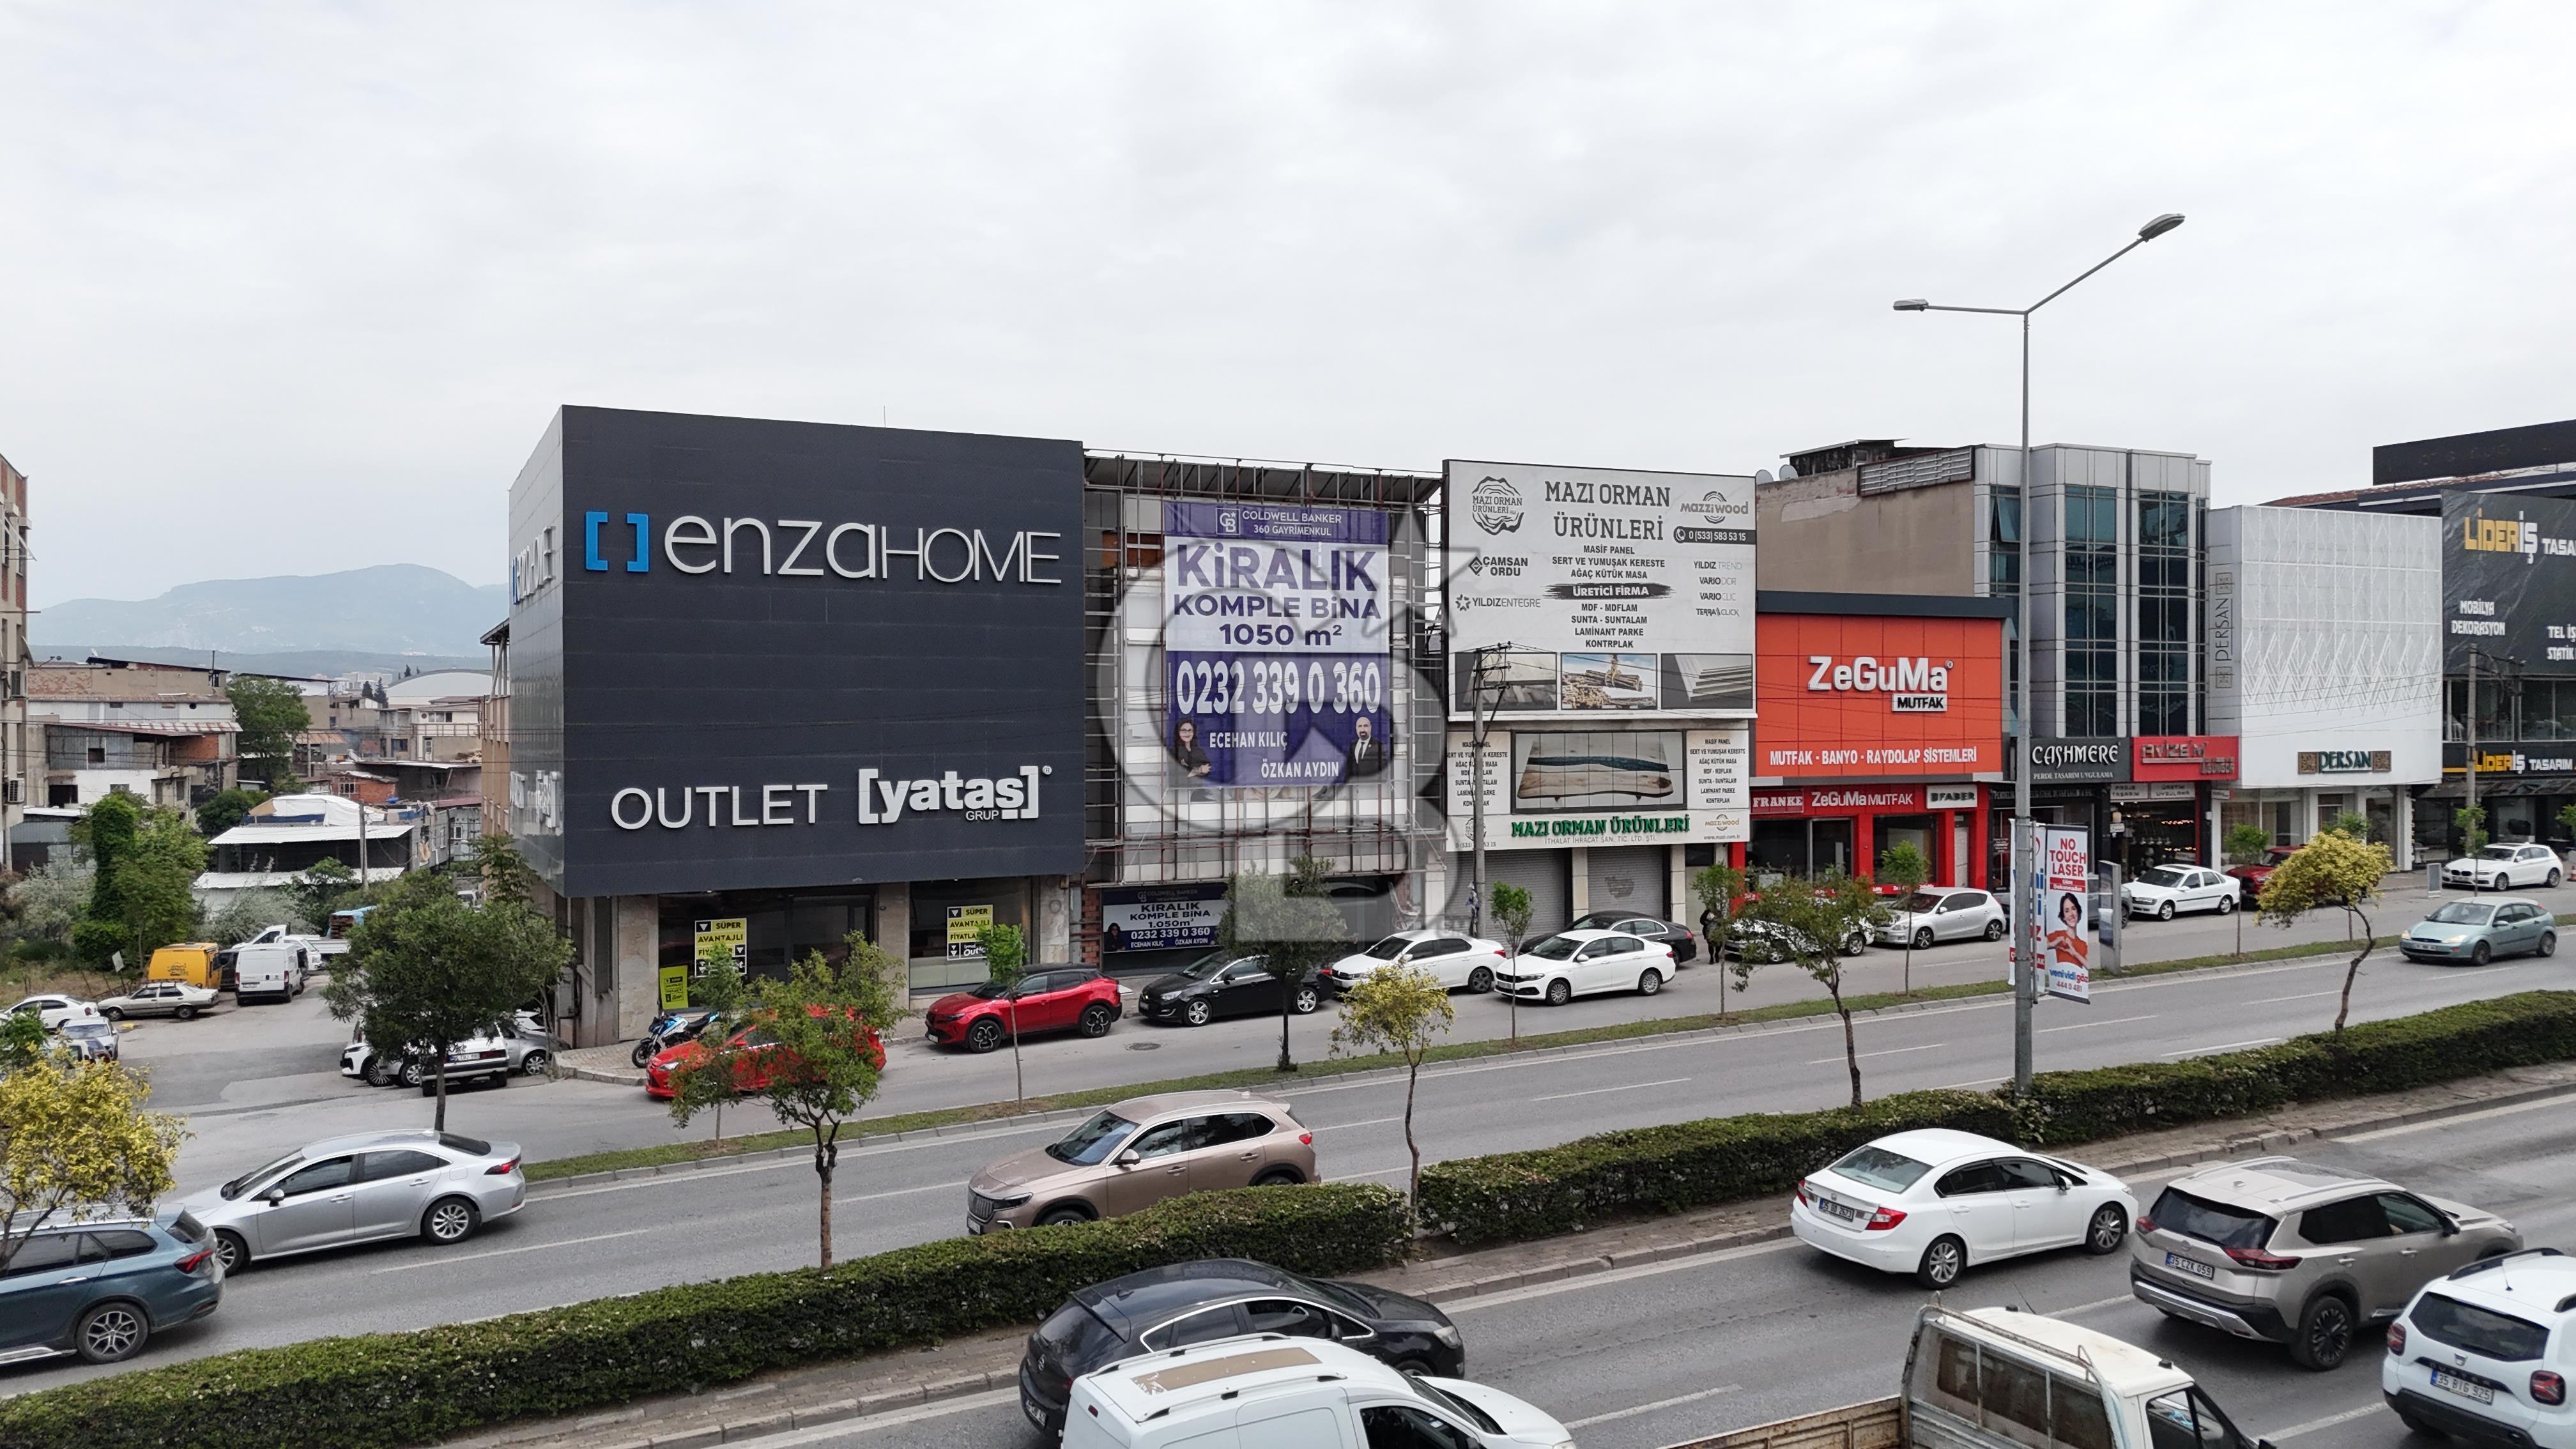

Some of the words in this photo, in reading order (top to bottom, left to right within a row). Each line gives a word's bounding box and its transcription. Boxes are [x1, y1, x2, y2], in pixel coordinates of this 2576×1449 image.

[1545, 480, 1595, 503] MAZI
[1599, 484, 1671, 507] ORMAN
[1472, 495, 1492, 505] MAZI
[1493, 496, 1523, 506] ORMAN
[1472, 503, 1509, 514] ÜRÜNLERİ
[1242, 510, 1299, 522] COLDWELL
[1301, 513, 1342, 524] BANKER
[1254, 525, 1270, 534] 360
[1272, 525, 1331, 536] GAYRİMENKUL
[1553, 511, 1664, 540] ÜRÜNLERİ
[1695, 531, 1713, 542] (533)
[1713, 532, 1727, 540] 583
[1728, 532, 1738, 541] 53
[1738, 533, 1746, 541] 15
[1583, 544, 1607, 553] MASİF
[1610, 546, 1635, 555] PANEL
[1552, 556, 1573, 565] SERT
[1575, 557, 1586, 565] VE
[1588, 558, 1627, 568] YUMUŞAK
[1630, 558, 1666, 567] KERESTE
[1693, 561, 1716, 569] YILDIZ
[1718, 562, 1743, 570] TREND
[1490, 567, 1521, 576] ORDU
[1570, 569, 1593, 579] AĞAÇ
[1595, 569, 1623, 578] KÜTÜK
[1625, 570, 1648, 579] MASA
[1572, 586, 1613, 597] ÜRETİCİ
[1615, 586, 1649, 596] FİRMA
[1174, 594, 1300, 618] KOMPLE
[1581, 603, 1598, 611] MDF
[1604, 604, 1637, 612] MDFLAM
[2460, 598, 2495, 615] MOBİLYA
[1571, 615, 1598, 624] SUNTA
[1604, 616, 1647, 624] SUNTALAM
[1575, 626, 1616, 636] LAMİNANT
[1618, 627, 1644, 636] PARKE
[2215, 597, 2232, 661] DERSAN
[2451, 620, 2506, 636] DEKORASYON
[2547, 625, 2566, 639] TEL
[1219, 624, 1294, 646] 1050
[1585, 640, 1634, 648] KONTRPLAK
[2547, 644, 2574, 661] STATİK
[1807, 656, 1947, 692] ZeGuMa
[1176, 660, 1245, 715] 0232
[1252, 661, 1300, 715] 339
[1307, 661, 1325, 715] 0
[1332, 661, 1381, 714] 360
[1897, 696, 1944, 709] MUTFAK
[1209, 732, 1255, 749] ECEHAN
[1258, 731, 1288, 751] KILIÇ
[1770, 751, 1813, 765] MUTFAK
[1821, 750, 1858, 765] BANYO
[1866, 749, 1920, 764] RAYDOLAP
[1923, 746, 1977, 763] SİSTEMLERİ
[2032, 745, 2119, 769] CASHMERE
[2319, 750, 2372, 772] DERSAN
[1261, 758, 1301, 779] ÖZKAN
[1305, 761, 1339, 778] AYDIN
[2529, 758, 2573, 770] TASARIM
[611, 784, 828, 830] OUTLET
[1752, 796, 1802, 808] FRANKE
[965, 810, 999, 821] GRUP
[1511, 820, 1549, 838] MAZI
[1551, 819, 1607, 836] ORMAN
[1609, 813, 1690, 834] ÜRÜNLERİ
[2060, 838, 2076, 850] NO
[2049, 850, 2086, 864] TOUCH
[2052, 862, 2083, 877] LASER
[965, 907, 988, 916] SÜPER
[1130, 912, 1179, 921] KOMPLE
[716, 921, 741, 930] SÜPER
[1130, 930, 1158, 940] 0232
[1160, 929, 1179, 938] 339
[1182, 928, 1188, 937] 0
[1190, 927, 1210, 936] 360
[2056, 981, 2067, 989] 444
[2171, 1255, 2179, 1266] 35
[2181, 1259, 2195, 1271] CZK
[2197, 1264, 2211, 1276] 059
[2437, 1374, 2449, 1386] 35
